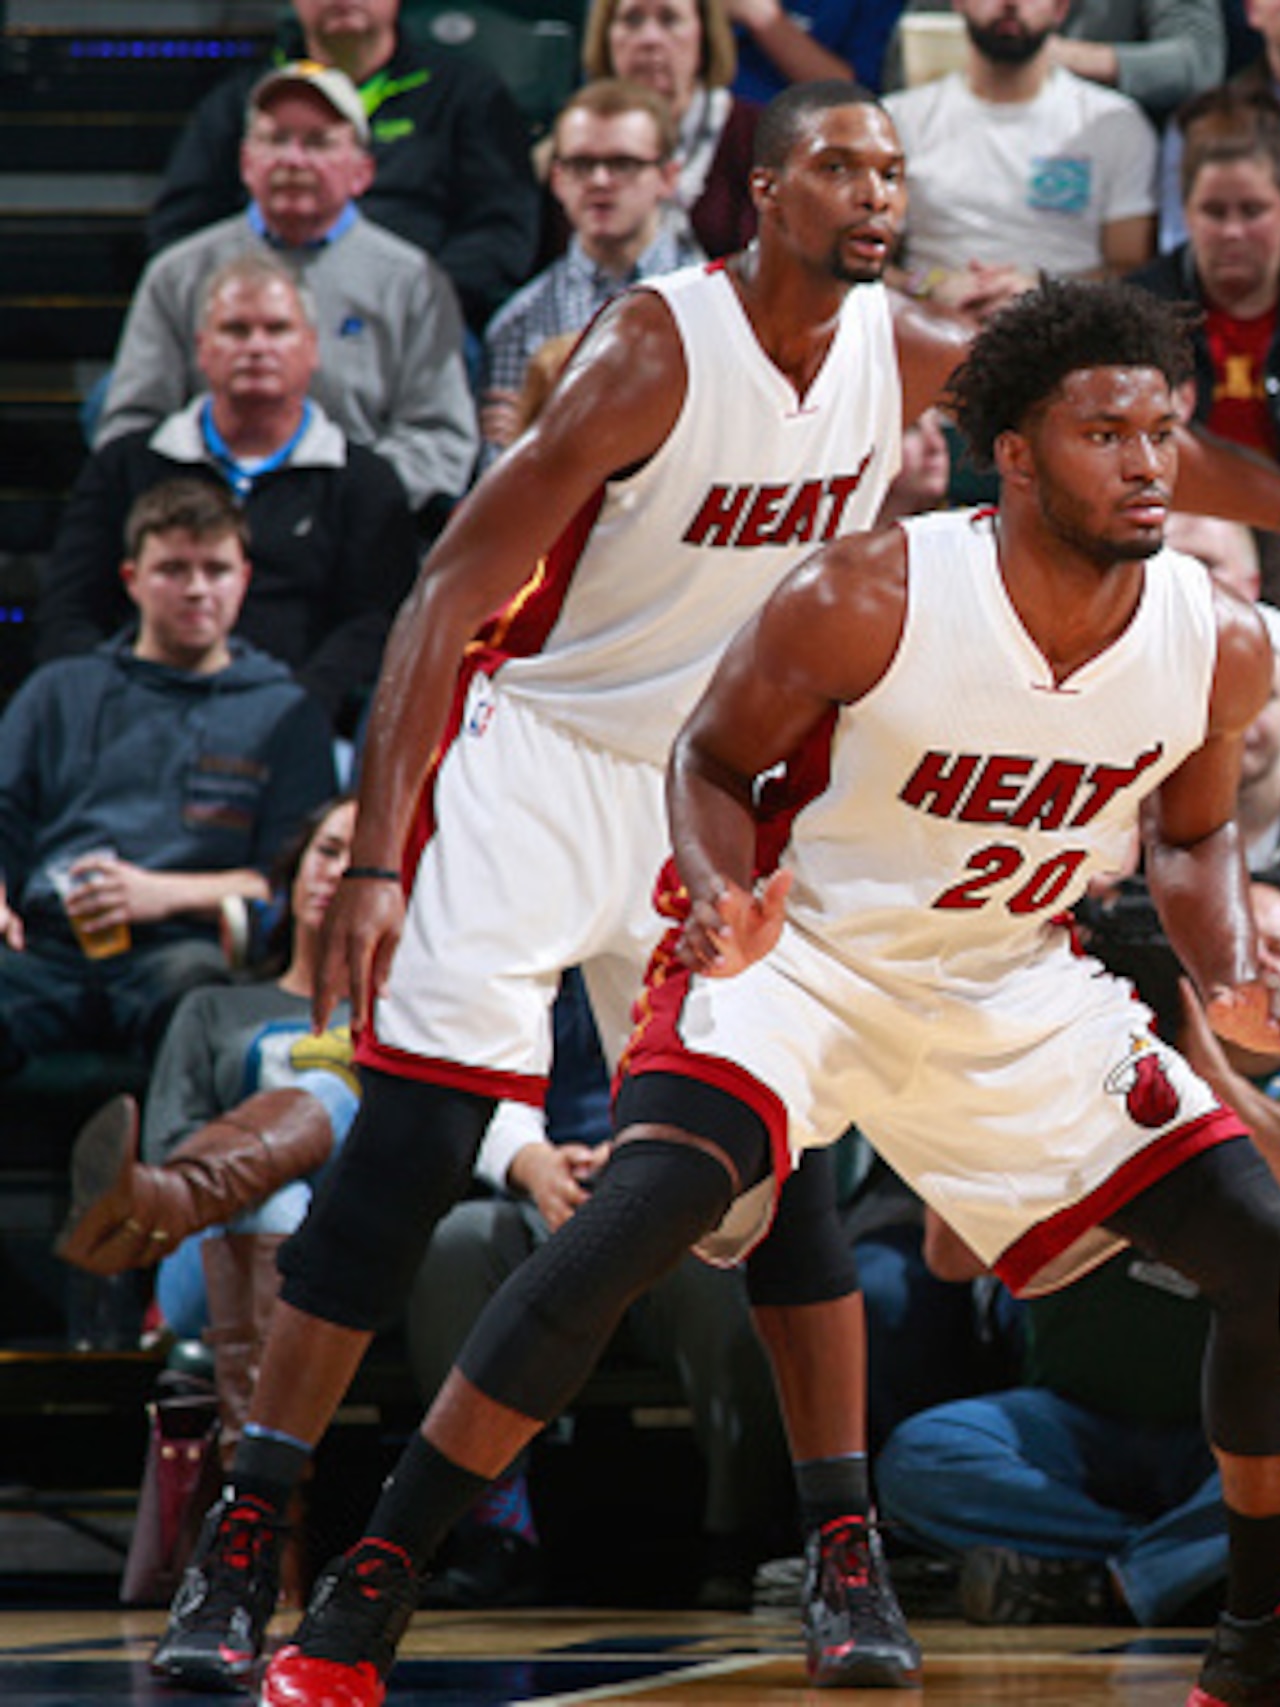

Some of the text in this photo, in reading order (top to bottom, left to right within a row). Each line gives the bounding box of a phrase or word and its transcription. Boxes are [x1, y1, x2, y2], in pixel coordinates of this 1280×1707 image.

[681, 447, 874, 547] HEAT
[899, 742, 1162, 830] HEAT
[931, 844, 1088, 914] 20
